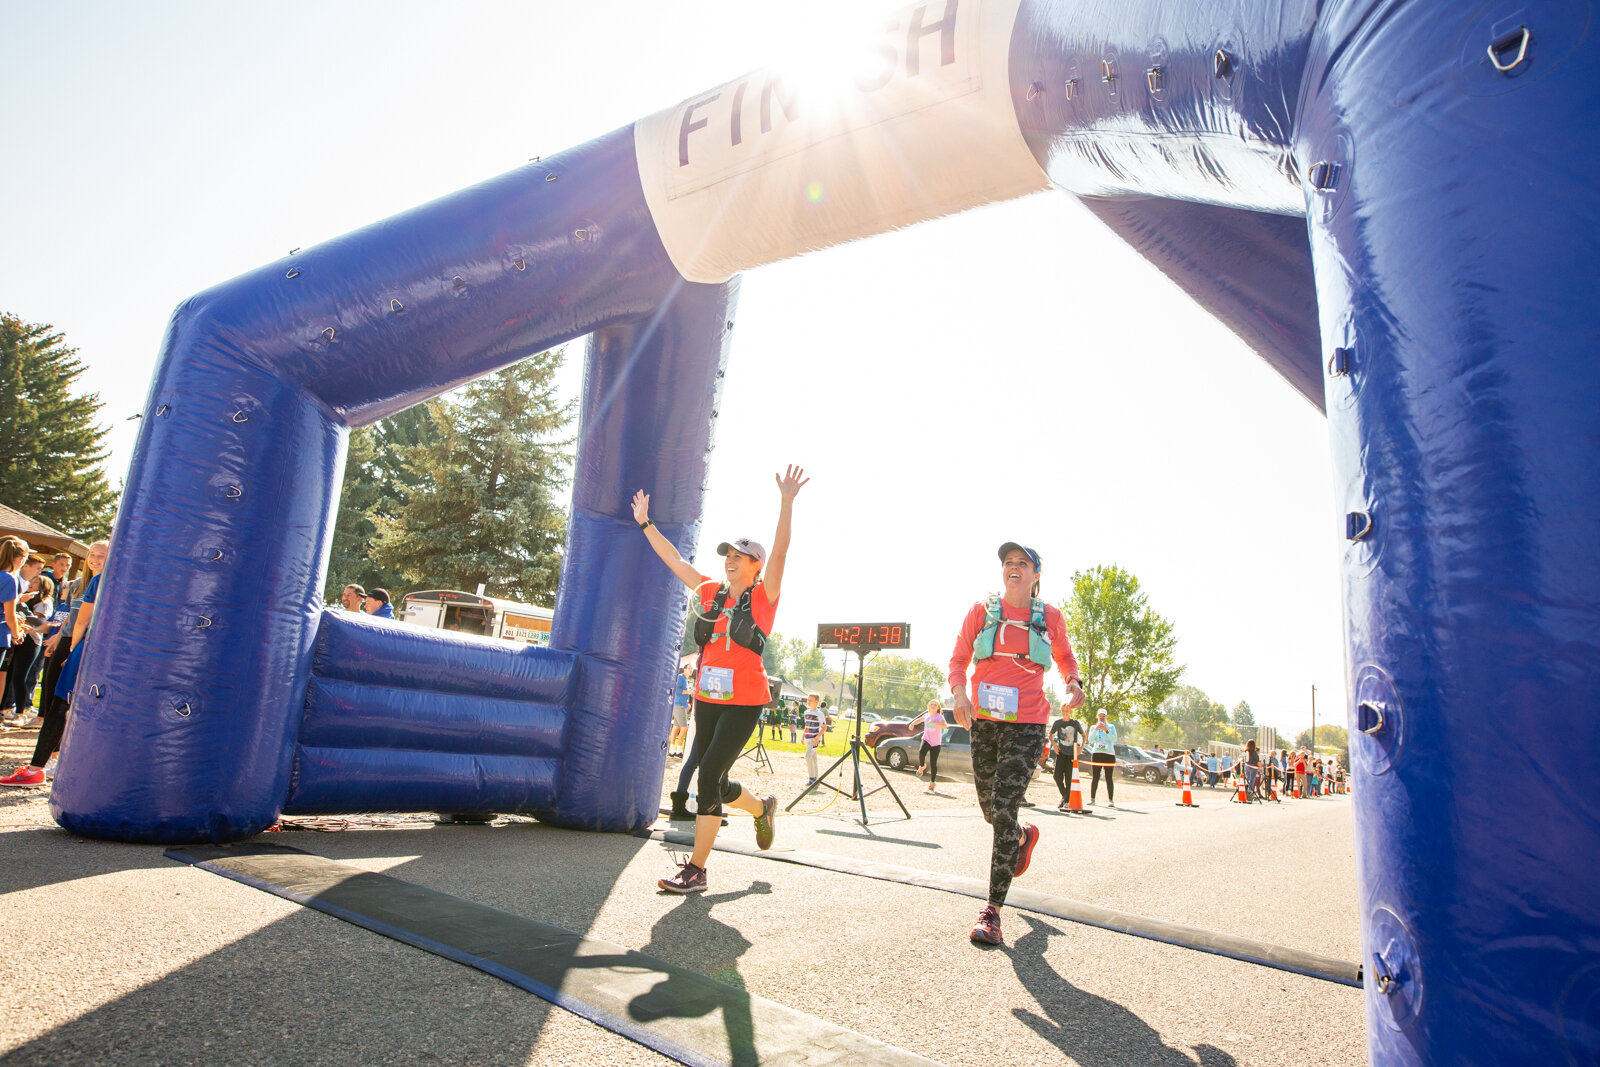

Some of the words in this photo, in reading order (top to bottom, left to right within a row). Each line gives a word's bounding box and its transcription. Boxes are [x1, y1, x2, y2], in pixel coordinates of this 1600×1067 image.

[679, 0, 958, 167] FINSH
[708, 677, 721, 691] 55
[988, 695, 1004, 710] 56
